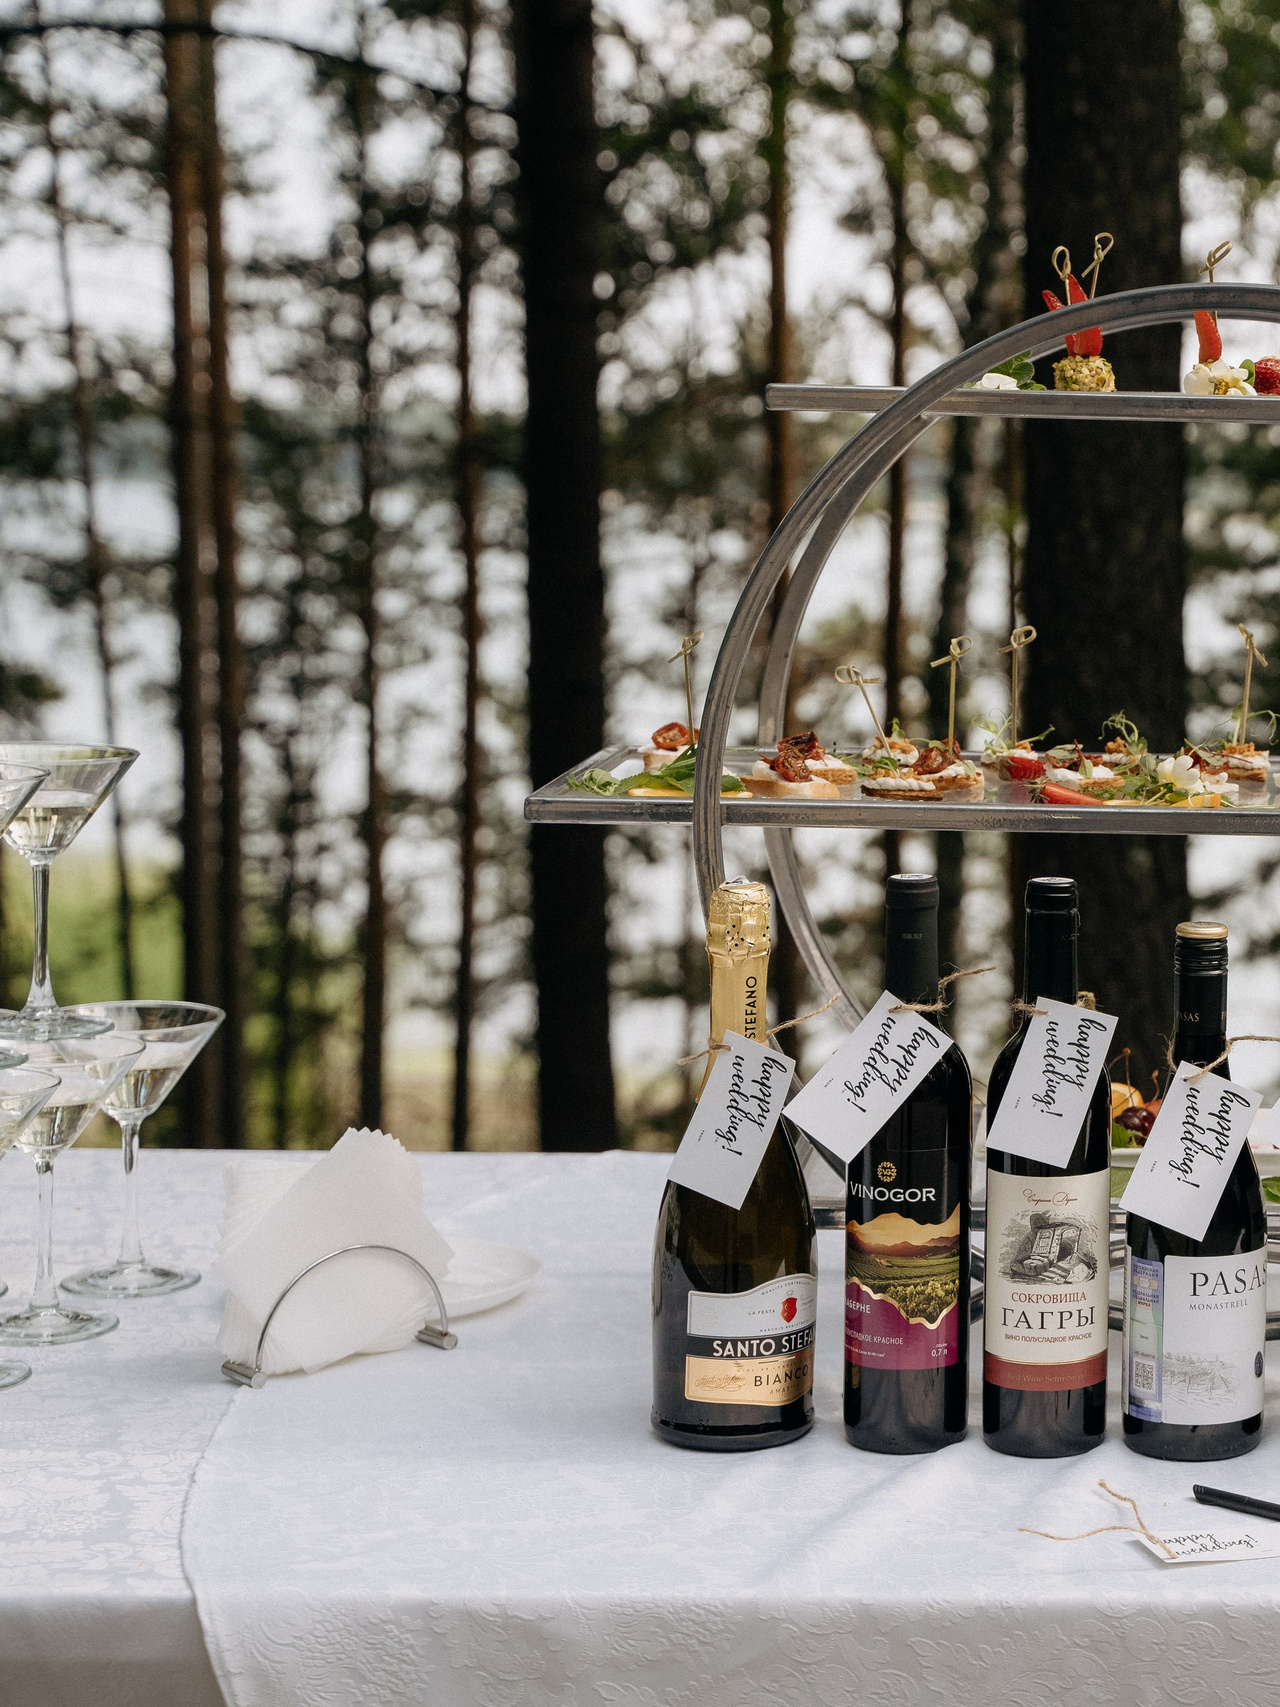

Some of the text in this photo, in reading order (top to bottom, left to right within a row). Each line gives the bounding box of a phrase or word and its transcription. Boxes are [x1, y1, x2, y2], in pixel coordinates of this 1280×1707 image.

[744, 975, 758, 1039] STEFANO
[843, 1016, 897, 1114] wedding!
[881, 1026, 940, 1097] happy
[1064, 1017, 1107, 1092] happy
[1032, 1021, 1066, 1117] wedding!
[714, 1055, 750, 1156] wedding!
[747, 1055, 788, 1133] happy
[1169, 1087, 1206, 1188] wedding!
[1202, 1089, 1250, 1166] happy
[850, 1181, 936, 1202] VINOGOR
[845, 1298, 871, 1314] АБЕРНЕ
[1011, 1291, 1087, 1304] СОКРОВИЩА
[1189, 1299, 1248, 1311] MONASTRELL
[1001, 1306, 1096, 1330] ГАГРЫ
[713, 1338, 776, 1357] SANTO
[873, 1336, 904, 1345] КРАСНОЕ
[1004, 1331, 1093, 1344] ВИНО ПОЛУСЛАДКОЕ КРАСНОЕ
[754, 1364, 809, 1387] BIANCO
[1175, 1534, 1258, 1556] wedding!
